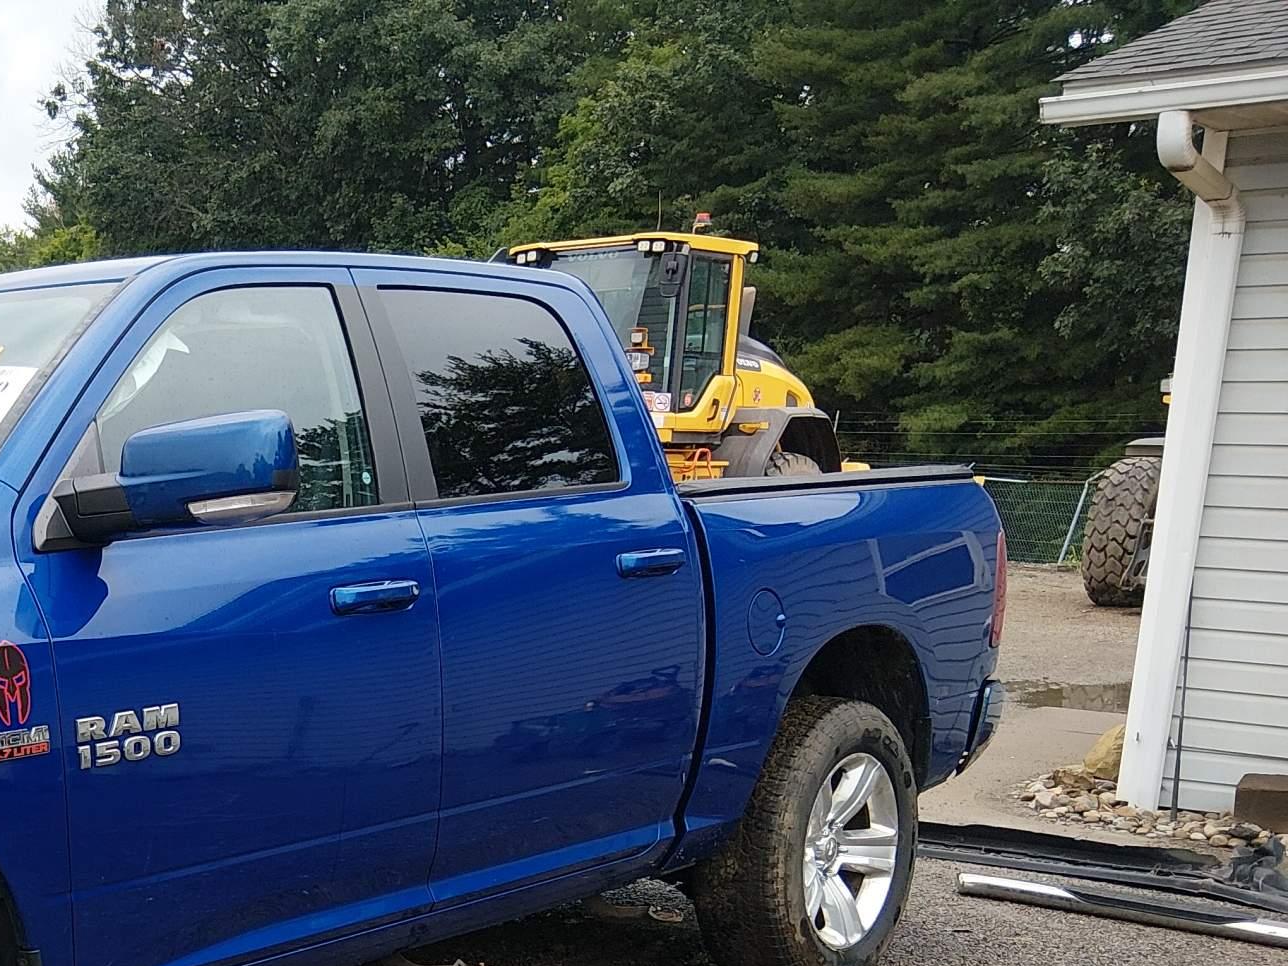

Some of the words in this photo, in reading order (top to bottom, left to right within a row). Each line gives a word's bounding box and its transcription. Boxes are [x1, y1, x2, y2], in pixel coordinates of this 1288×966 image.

[568, 250, 618, 262] VOLVO
[75, 703, 180, 744] RAM
[13, 742, 48, 757] LITER
[77, 730, 181, 770] 1500
